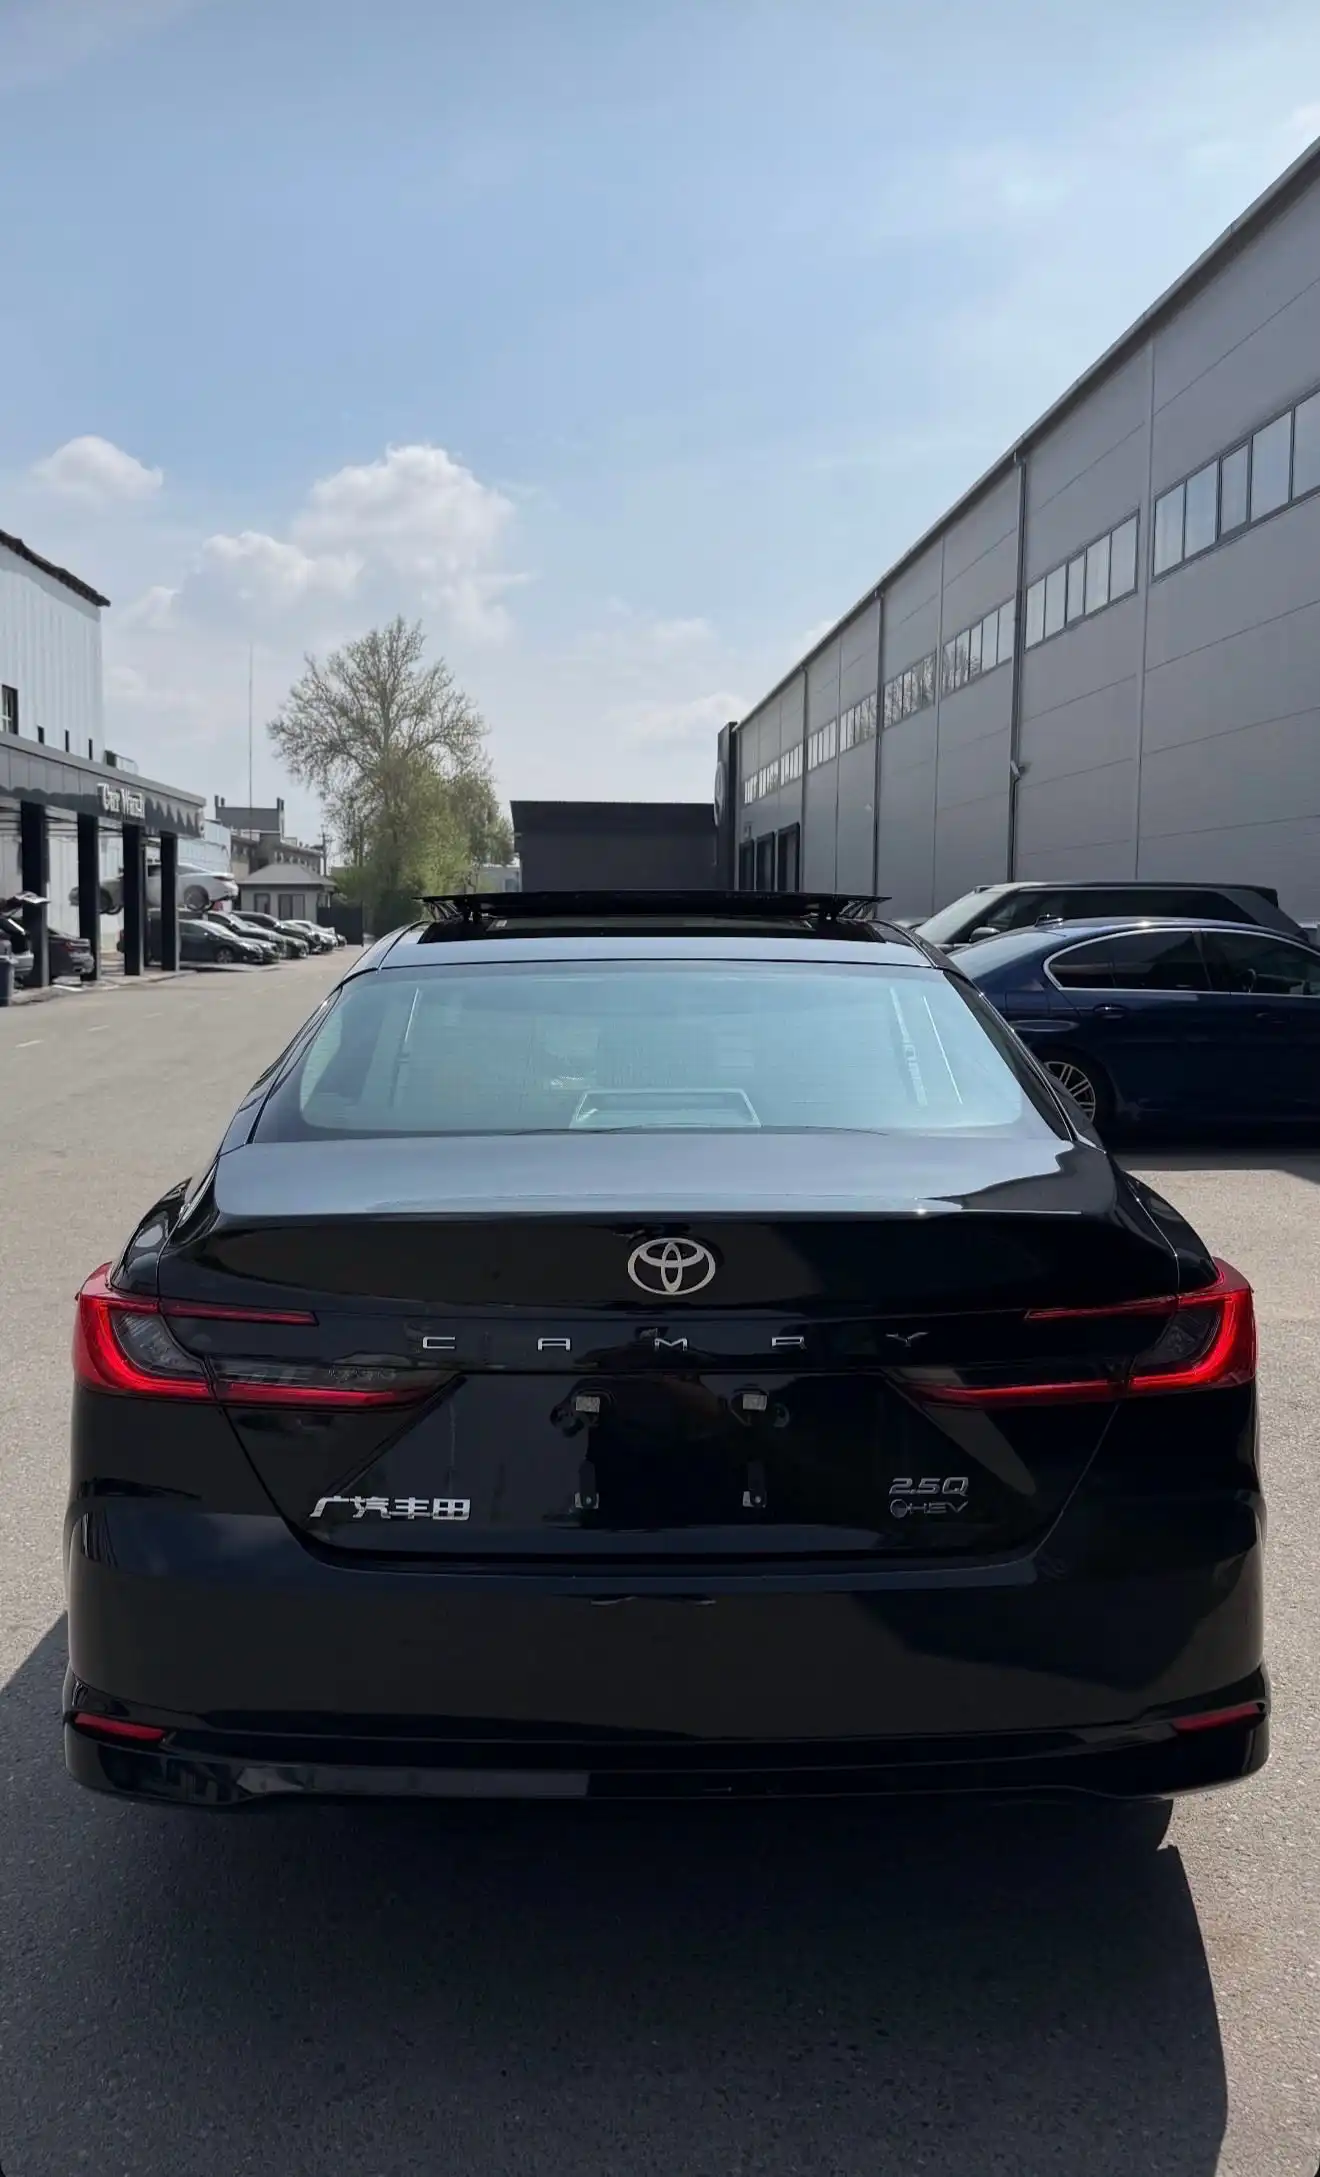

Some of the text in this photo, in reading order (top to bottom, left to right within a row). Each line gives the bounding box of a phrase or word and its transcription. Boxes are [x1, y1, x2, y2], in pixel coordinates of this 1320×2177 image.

[422, 1332, 929, 1351] CAMRY
[889, 1477, 968, 1496] 2.5Q
[309, 1495, 471, 1520] 广汽丰田
